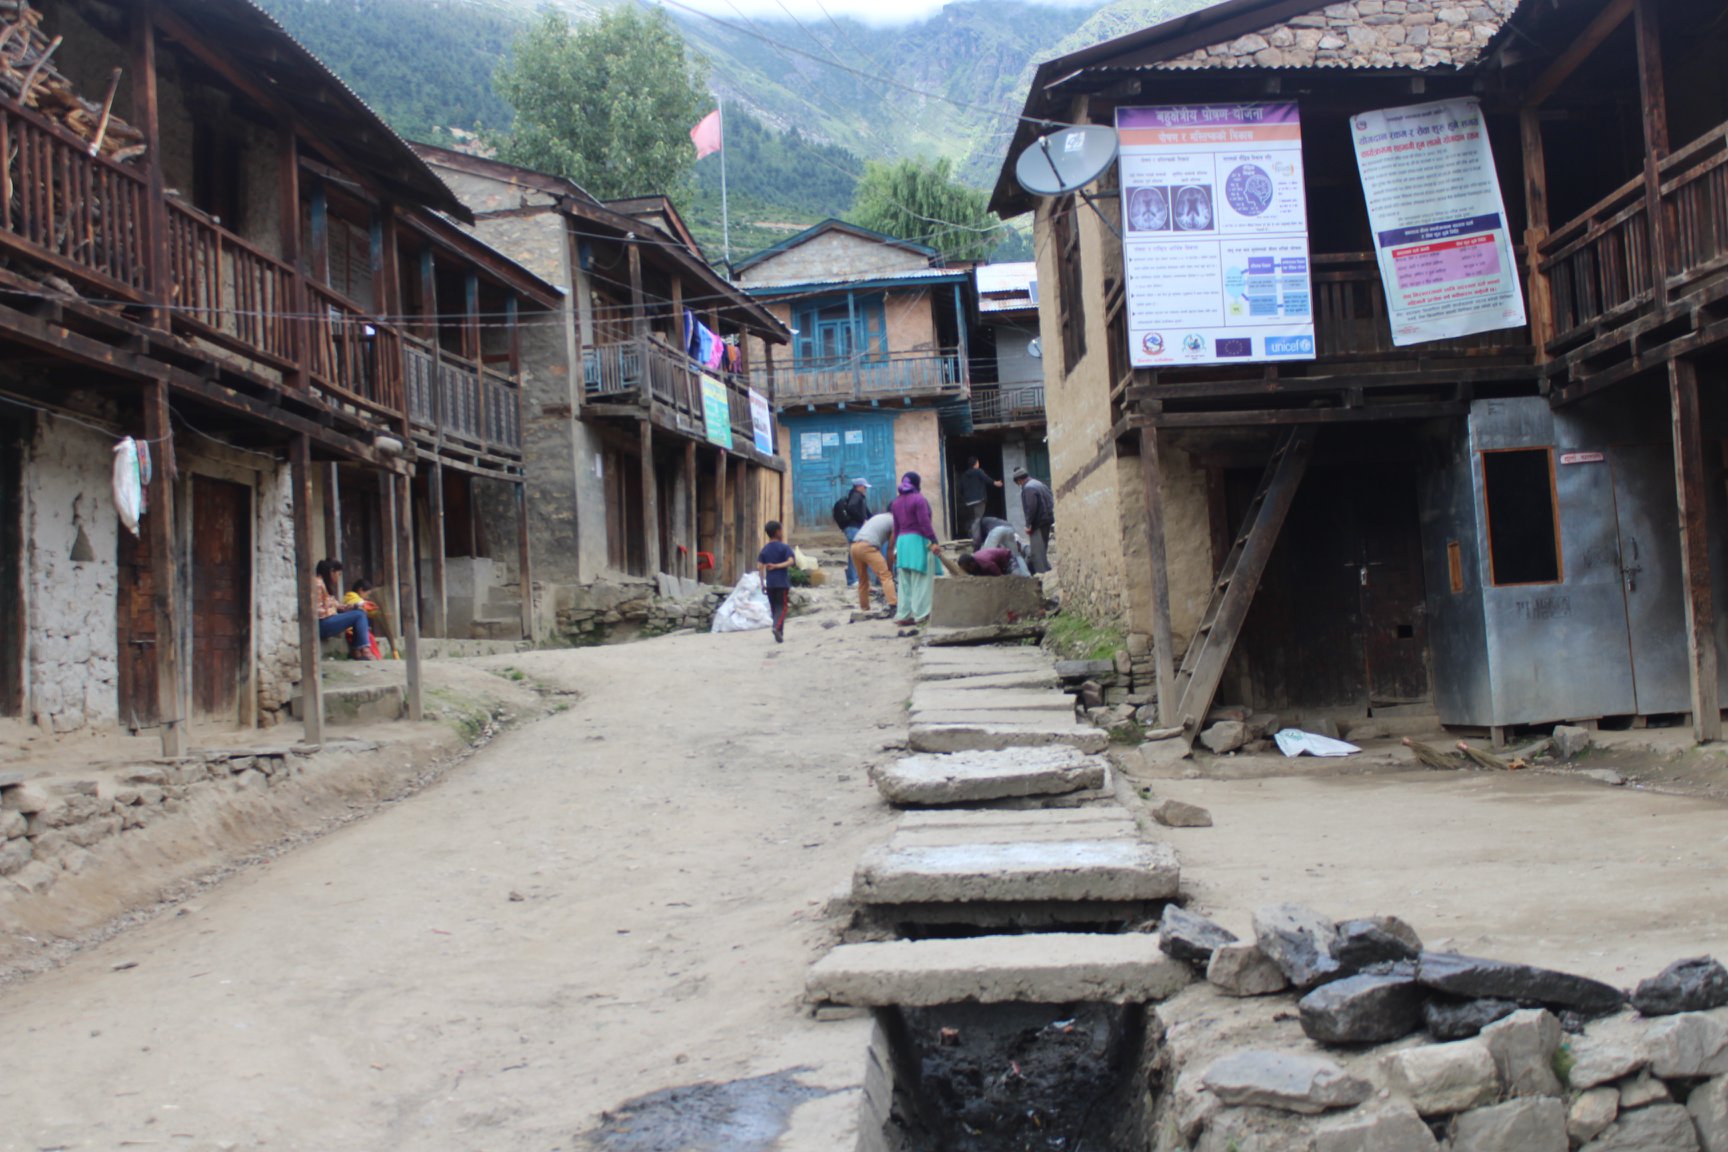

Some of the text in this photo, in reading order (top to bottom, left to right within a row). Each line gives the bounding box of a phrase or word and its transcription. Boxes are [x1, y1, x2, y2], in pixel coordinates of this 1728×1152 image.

[1201, 106, 1228, 122] पोषण
[1233, 105, 1264, 121] योजना
[1271, 340, 1300, 353] unicef
